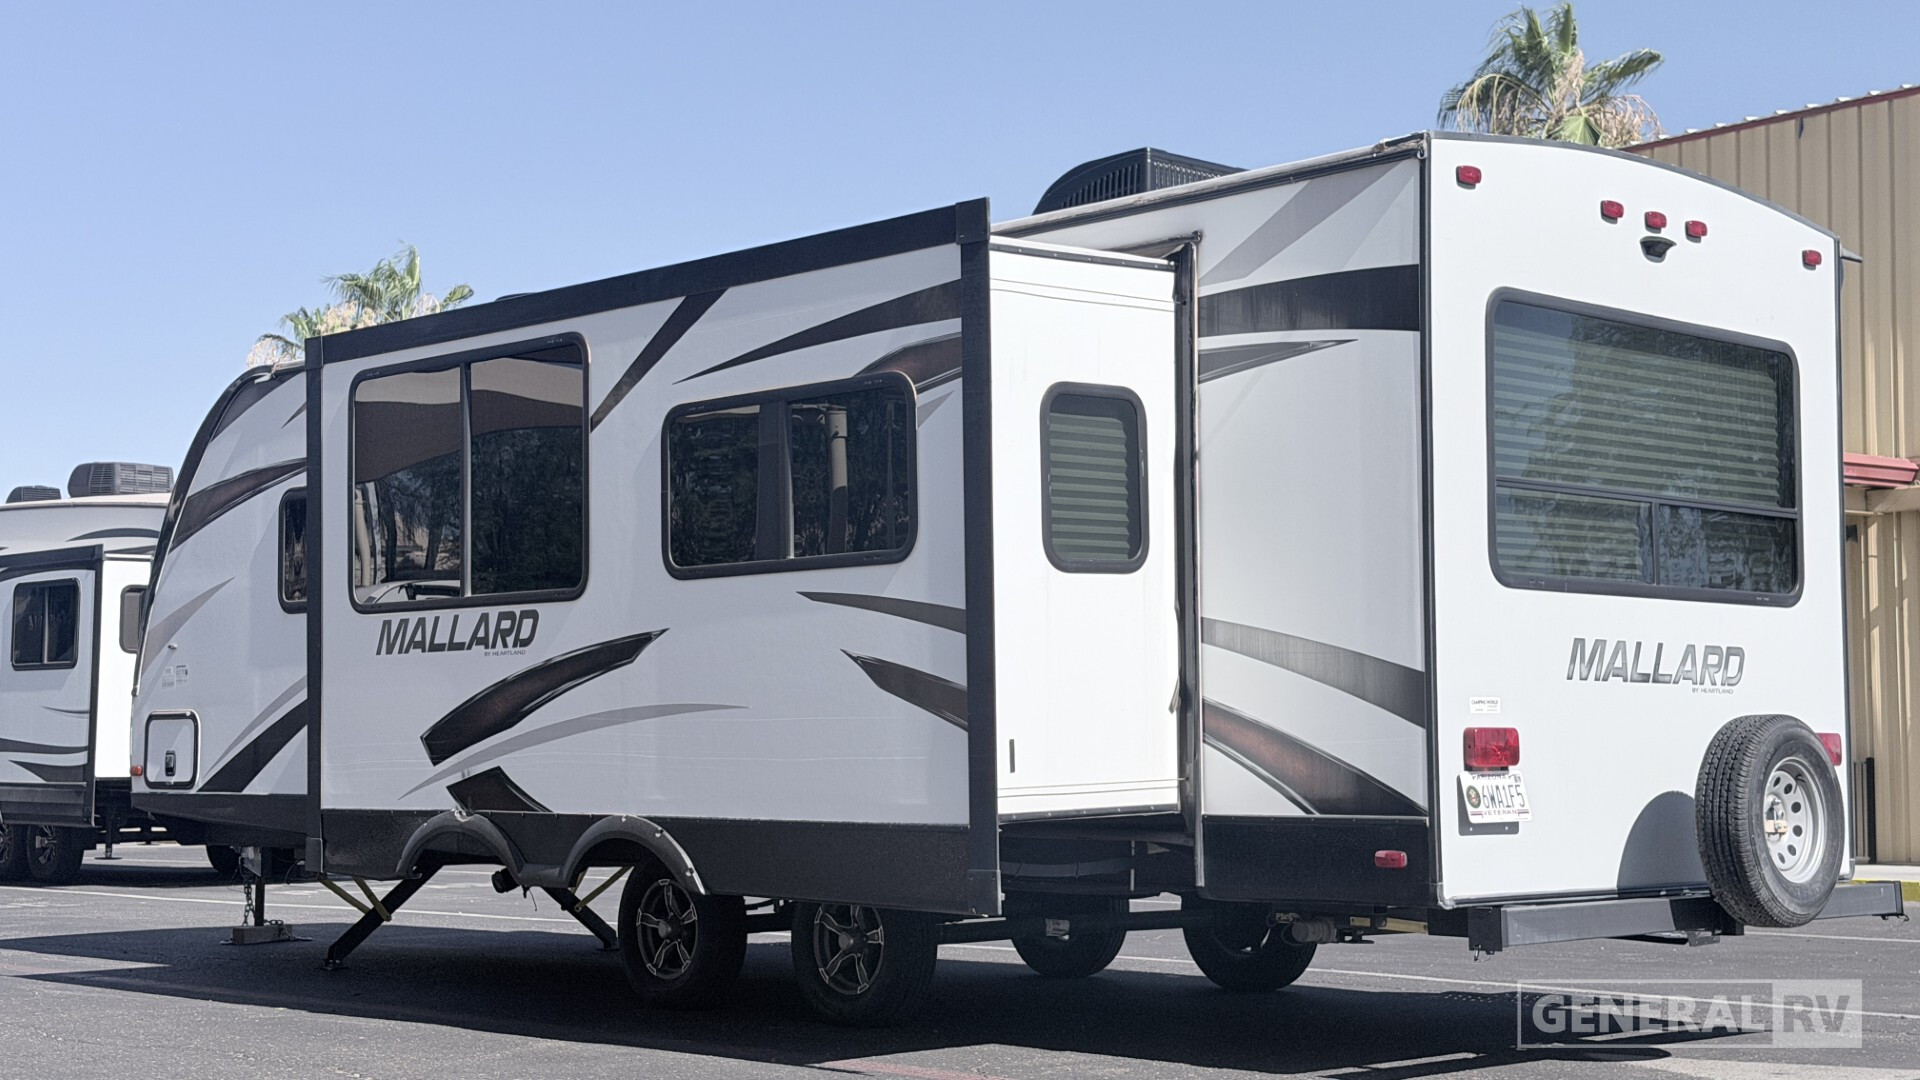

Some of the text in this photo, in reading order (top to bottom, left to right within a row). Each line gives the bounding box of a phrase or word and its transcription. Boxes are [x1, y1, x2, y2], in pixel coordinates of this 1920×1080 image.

[376, 609, 540, 655] MALLARD
[1566, 637, 1745, 686] MALLARD
[1482, 784, 1525, 808] 6WA1F5
